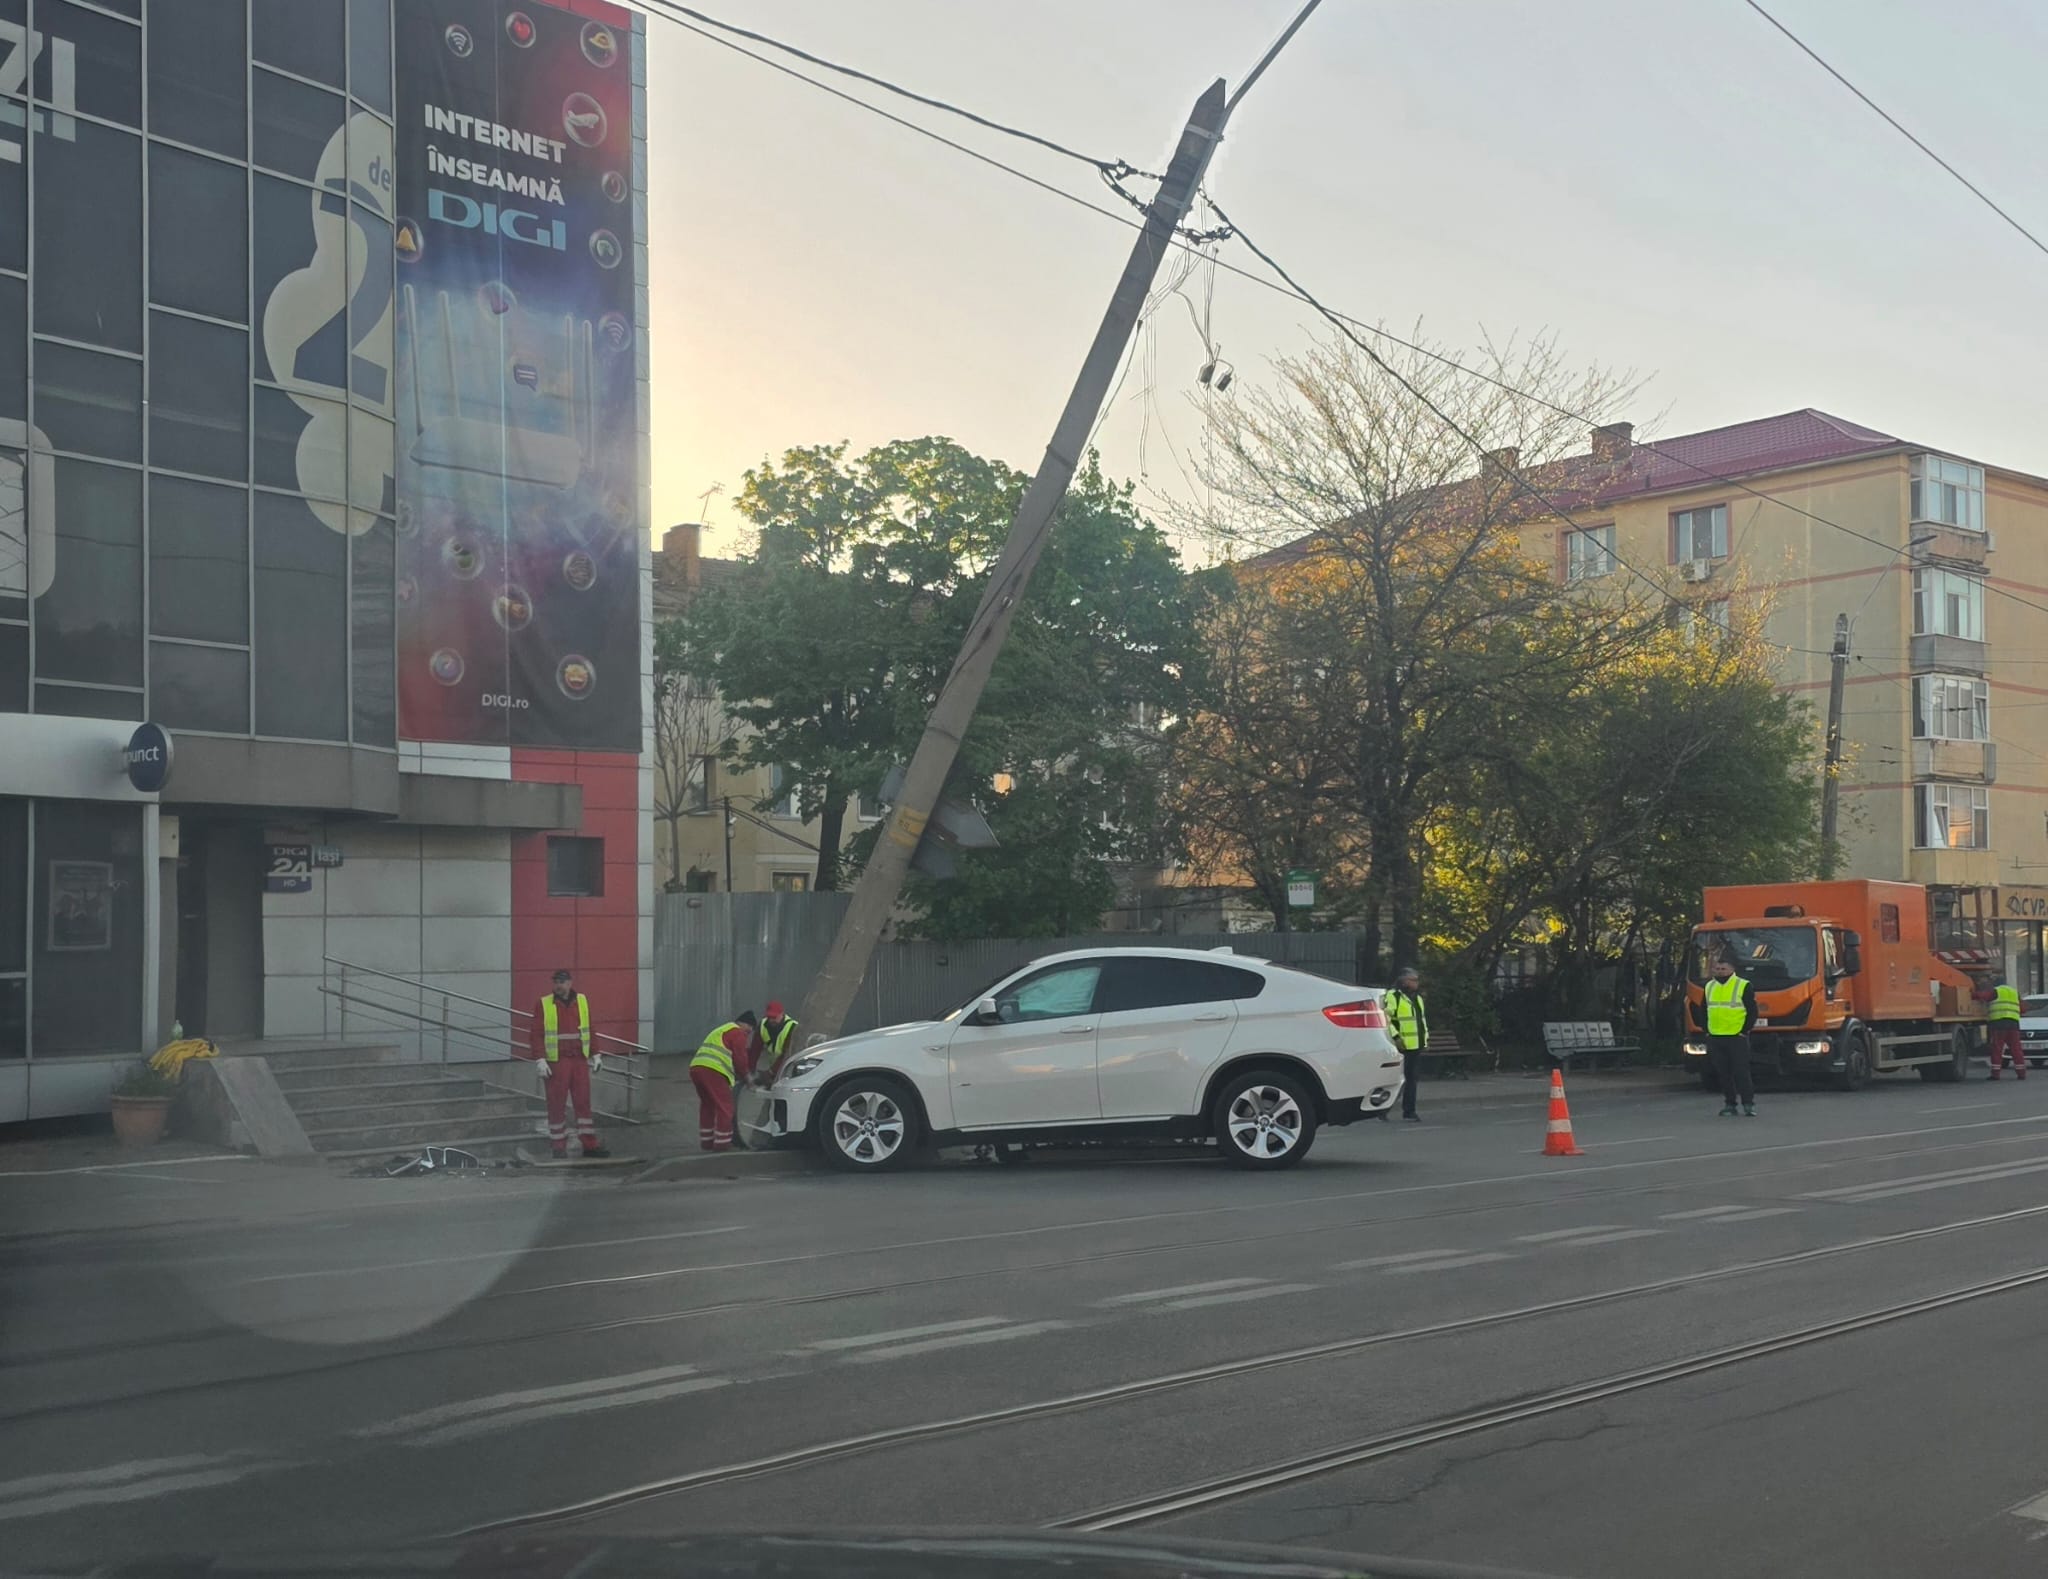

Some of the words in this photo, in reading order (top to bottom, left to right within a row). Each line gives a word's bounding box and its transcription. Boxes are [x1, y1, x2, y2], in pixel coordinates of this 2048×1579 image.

[424, 104, 566, 164] INTERNET
[368, 155, 391, 192] de
[426, 144, 566, 206] ÎNSEAMNĂ
[428, 188, 566, 251] DIGI
[482, 694, 529, 709] DIGI.ro
[268, 857, 312, 882] 24
[273, 847, 308, 856] DIGI
